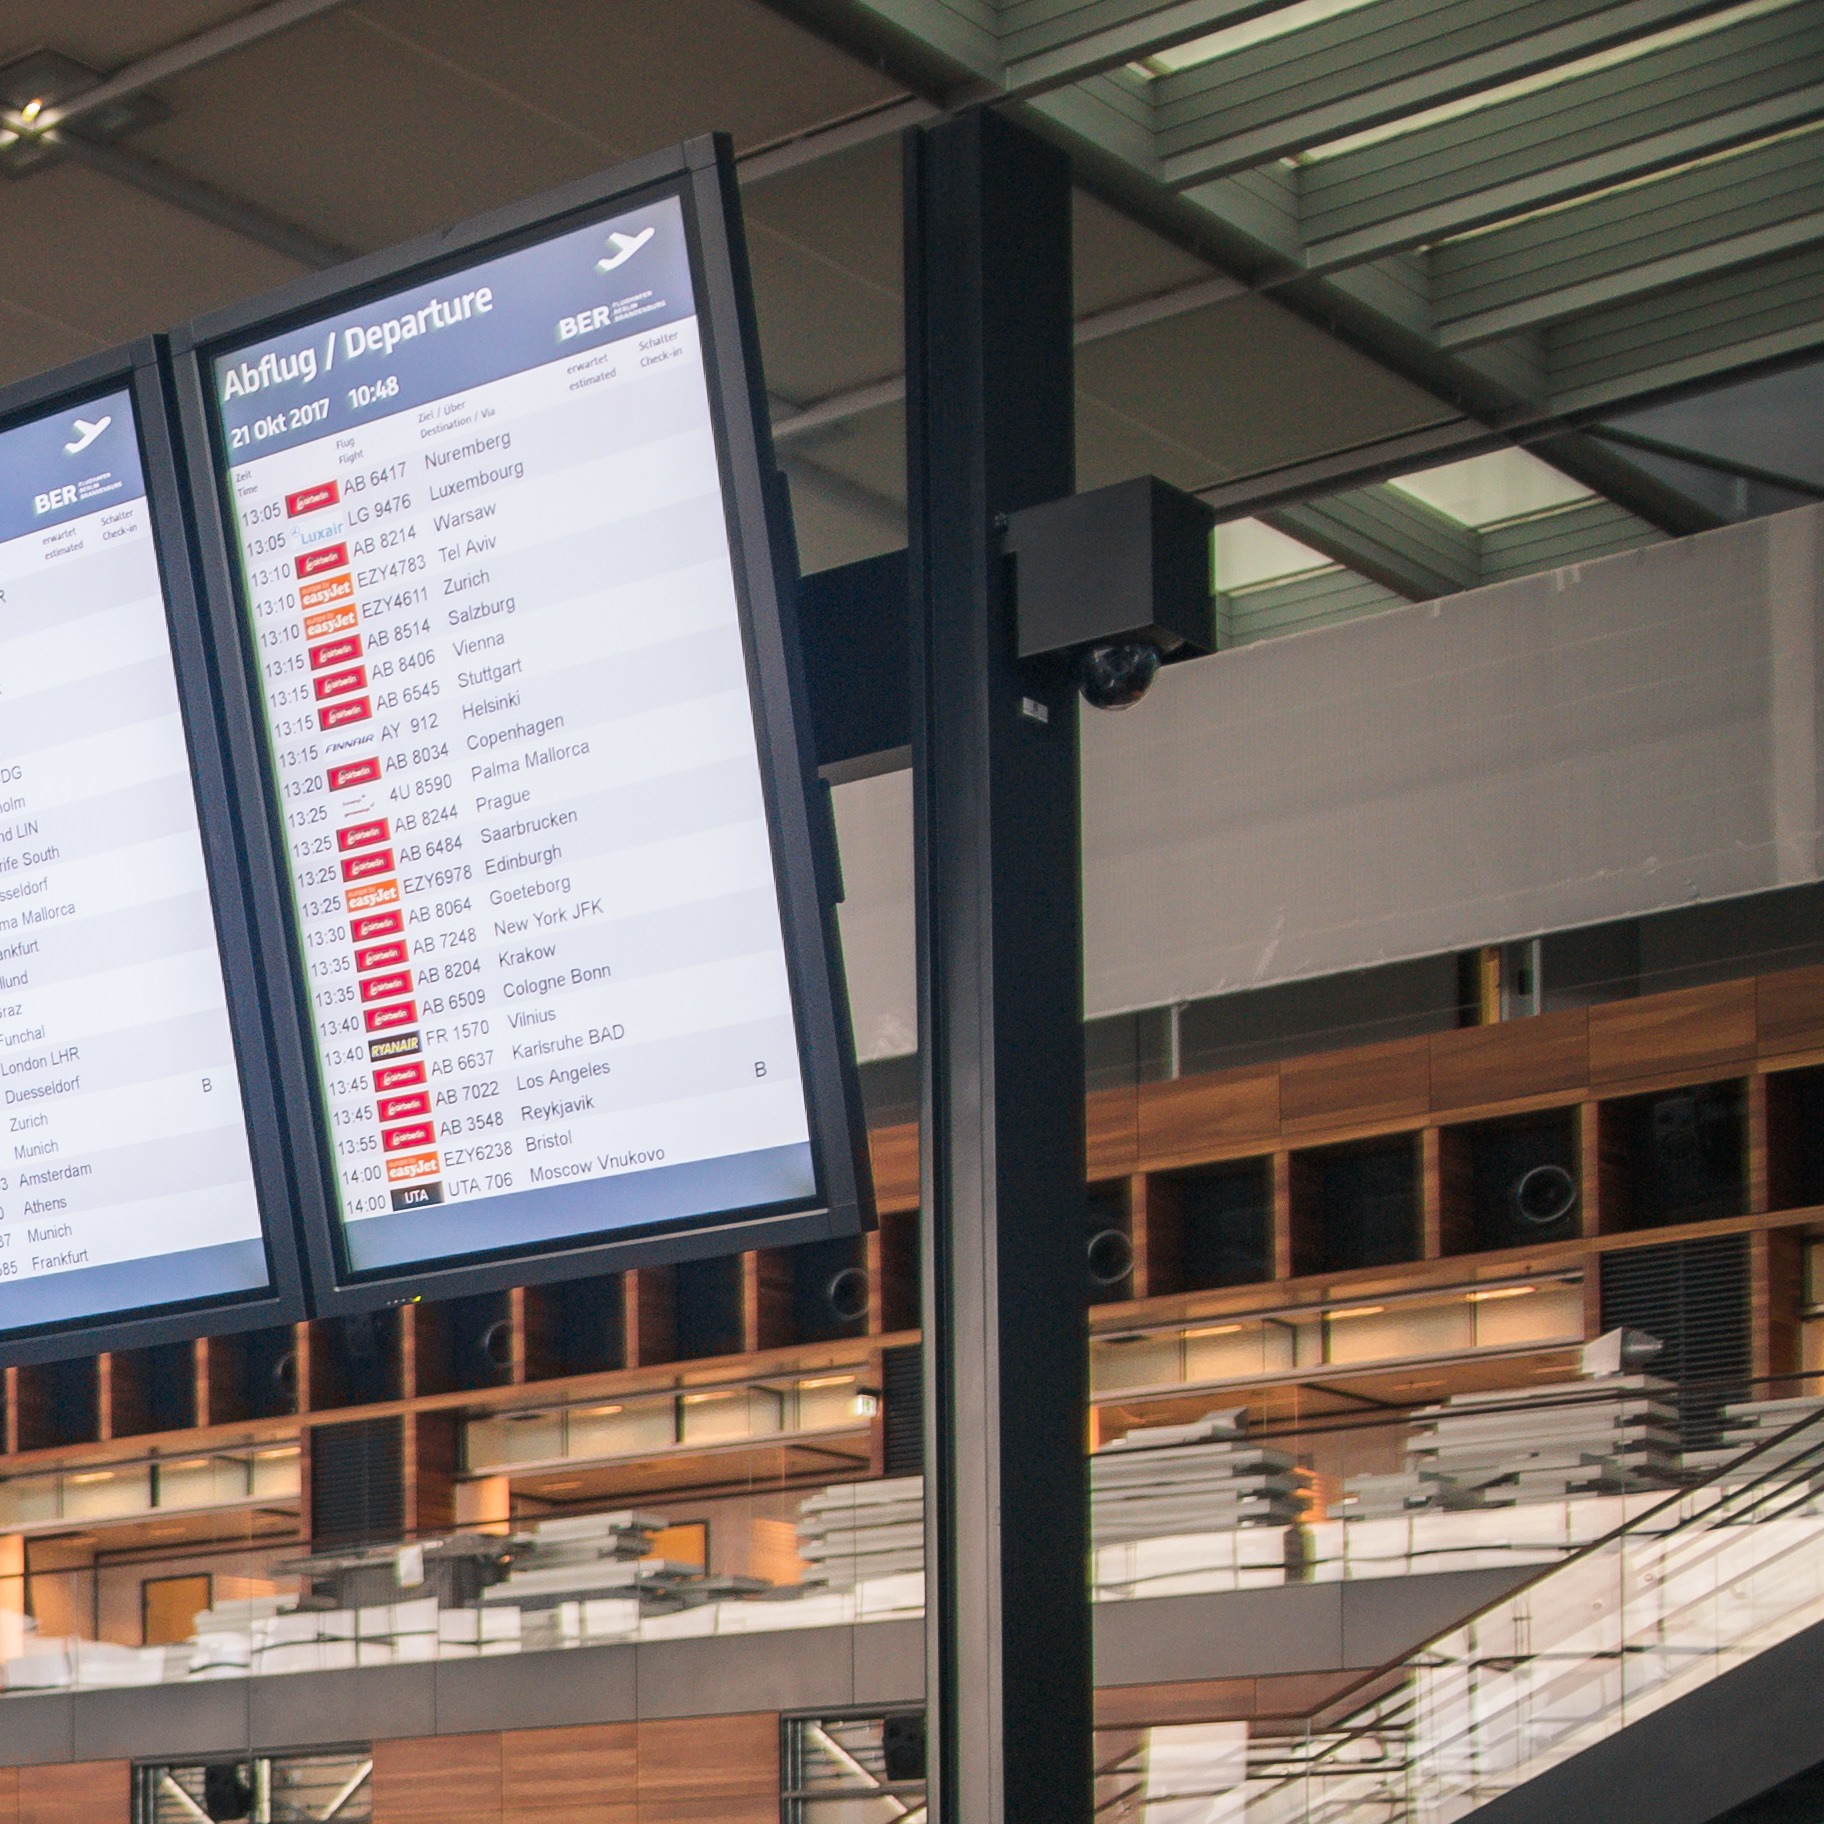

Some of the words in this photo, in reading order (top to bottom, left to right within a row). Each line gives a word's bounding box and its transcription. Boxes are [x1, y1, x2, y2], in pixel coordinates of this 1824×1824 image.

[224, 348, 317, 401] Abflug
[325, 332, 335, 370] /
[344, 287, 492, 358] Departure
[558, 306, 611, 340] BER
[638, 332, 678, 351] Schalter
[566, 354, 608, 374] erwartet
[569, 367, 616, 390] estimated
[639, 347, 683, 367] Check-in
[231, 425, 250, 448] 21
[254, 413, 287, 439] Okt
[289, 398, 329, 428] 2017
[348, 376, 399, 408] 10:48
[420, 416, 472, 439] Destination
[480, 408, 495, 418] Via
[336, 437, 355, 449] Flug
[338, 449, 364, 464] Flight
[34, 485, 77, 514] BER
[242, 501, 281, 526] 13:05
[344, 475, 366, 495] AB
[370, 461, 406, 486] 6417
[424, 432, 511, 469] Nuremberg
[246, 532, 285, 557] 13:05
[300, 523, 343, 544] Luxair
[348, 506, 369, 526] LG
[374, 493, 411, 518] 9476
[429, 462, 524, 501] Luxembourg
[279, 744, 318, 767] 13:15
[325, 734, 374, 753] FINNAIR
[381, 722, 400, 741] AY
[410, 712, 438, 733] 912
[462, 690, 520, 719] Helsinki
[324, 1046, 363, 1066] 13:40
[371, 1037, 418, 1057] RYANAIR
[426, 1028, 448, 1045] FR
[453, 1019, 489, 1039] 1570
[507, 1009, 556, 1028] Vilnius
[9, 1112, 48, 1132] Zurich
[201, 1077, 212, 1092] B
[338, 1135, 377, 1155] 13:55
[440, 1119, 462, 1136] AB
[466, 1111, 503, 1131] 3548
[521, 1094, 594, 1121] Reykjavik
[754, 1061, 767, 1077] B
[347, 1194, 385, 1214] 14:00
[404, 1189, 428, 1203] UTA
[448, 1178, 481, 1196] UTA
[484, 1171, 513, 1189] 706
[530, 1161, 592, 1182] Moscow
[597, 1148, 665, 1170] Vnukovo
